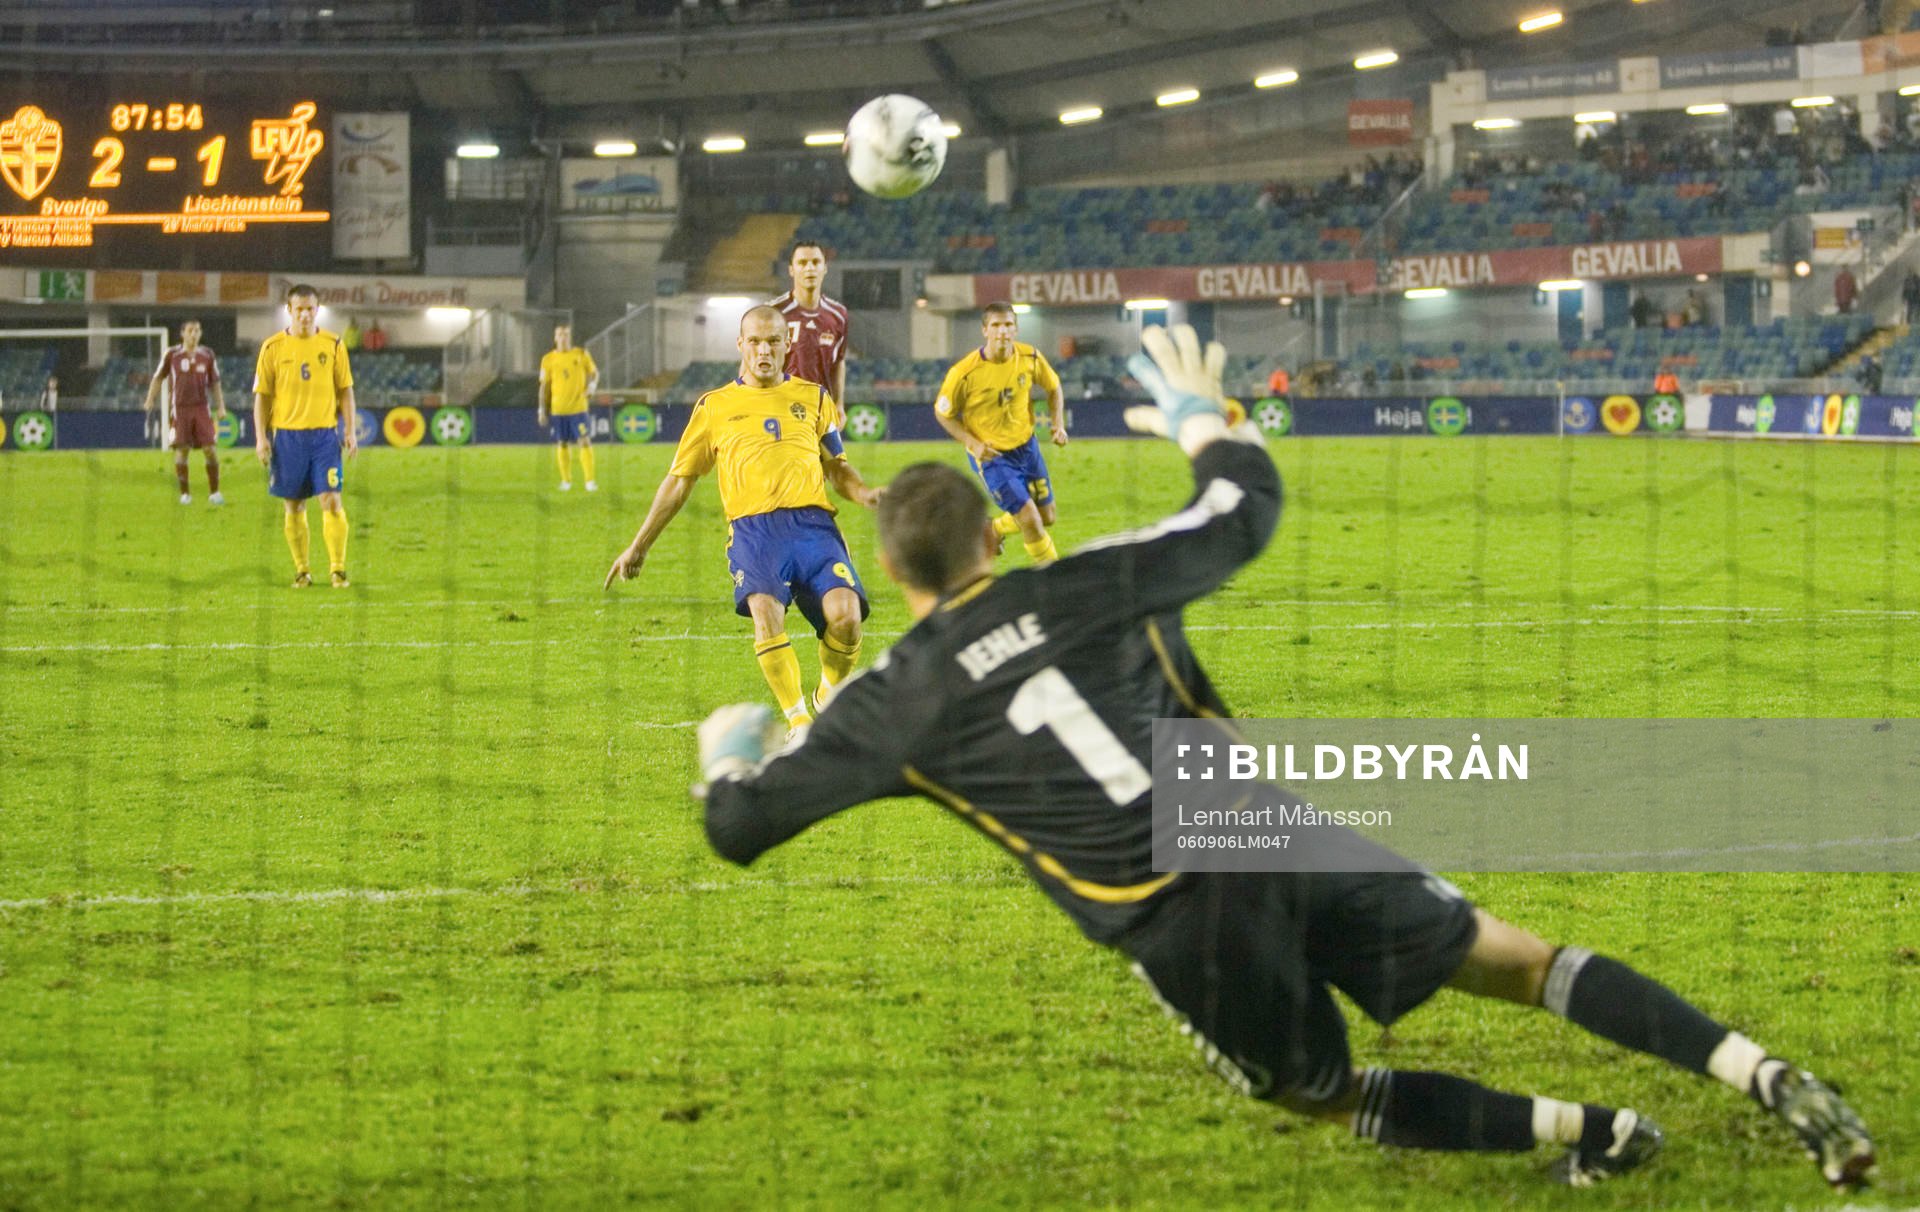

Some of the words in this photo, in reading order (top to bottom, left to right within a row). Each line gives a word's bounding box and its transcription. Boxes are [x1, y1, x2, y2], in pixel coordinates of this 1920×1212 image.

[111, 103, 203, 131] 87:54
[1350, 113, 1411, 130] GEVALIA
[252, 126, 301, 155] LFV
[89, 136, 124, 188] 2
[197, 135, 226, 187] 1
[1388, 253, 1495, 290] GEVALIA
[1572, 240, 1683, 277] GEVALIA
[1010, 271, 1121, 304] GEVALIA
[1197, 265, 1311, 297] GEVALIA
[300, 362, 311, 381] 6
[763, 418, 781, 441] 9
[1374, 406, 1422, 429] Heja
[327, 467, 339, 488] 6
[1027, 477, 1050, 500] 15
[832, 561, 856, 587] 9
[955, 612, 1048, 681] JEHLE
[1006, 665, 1152, 806] 1
